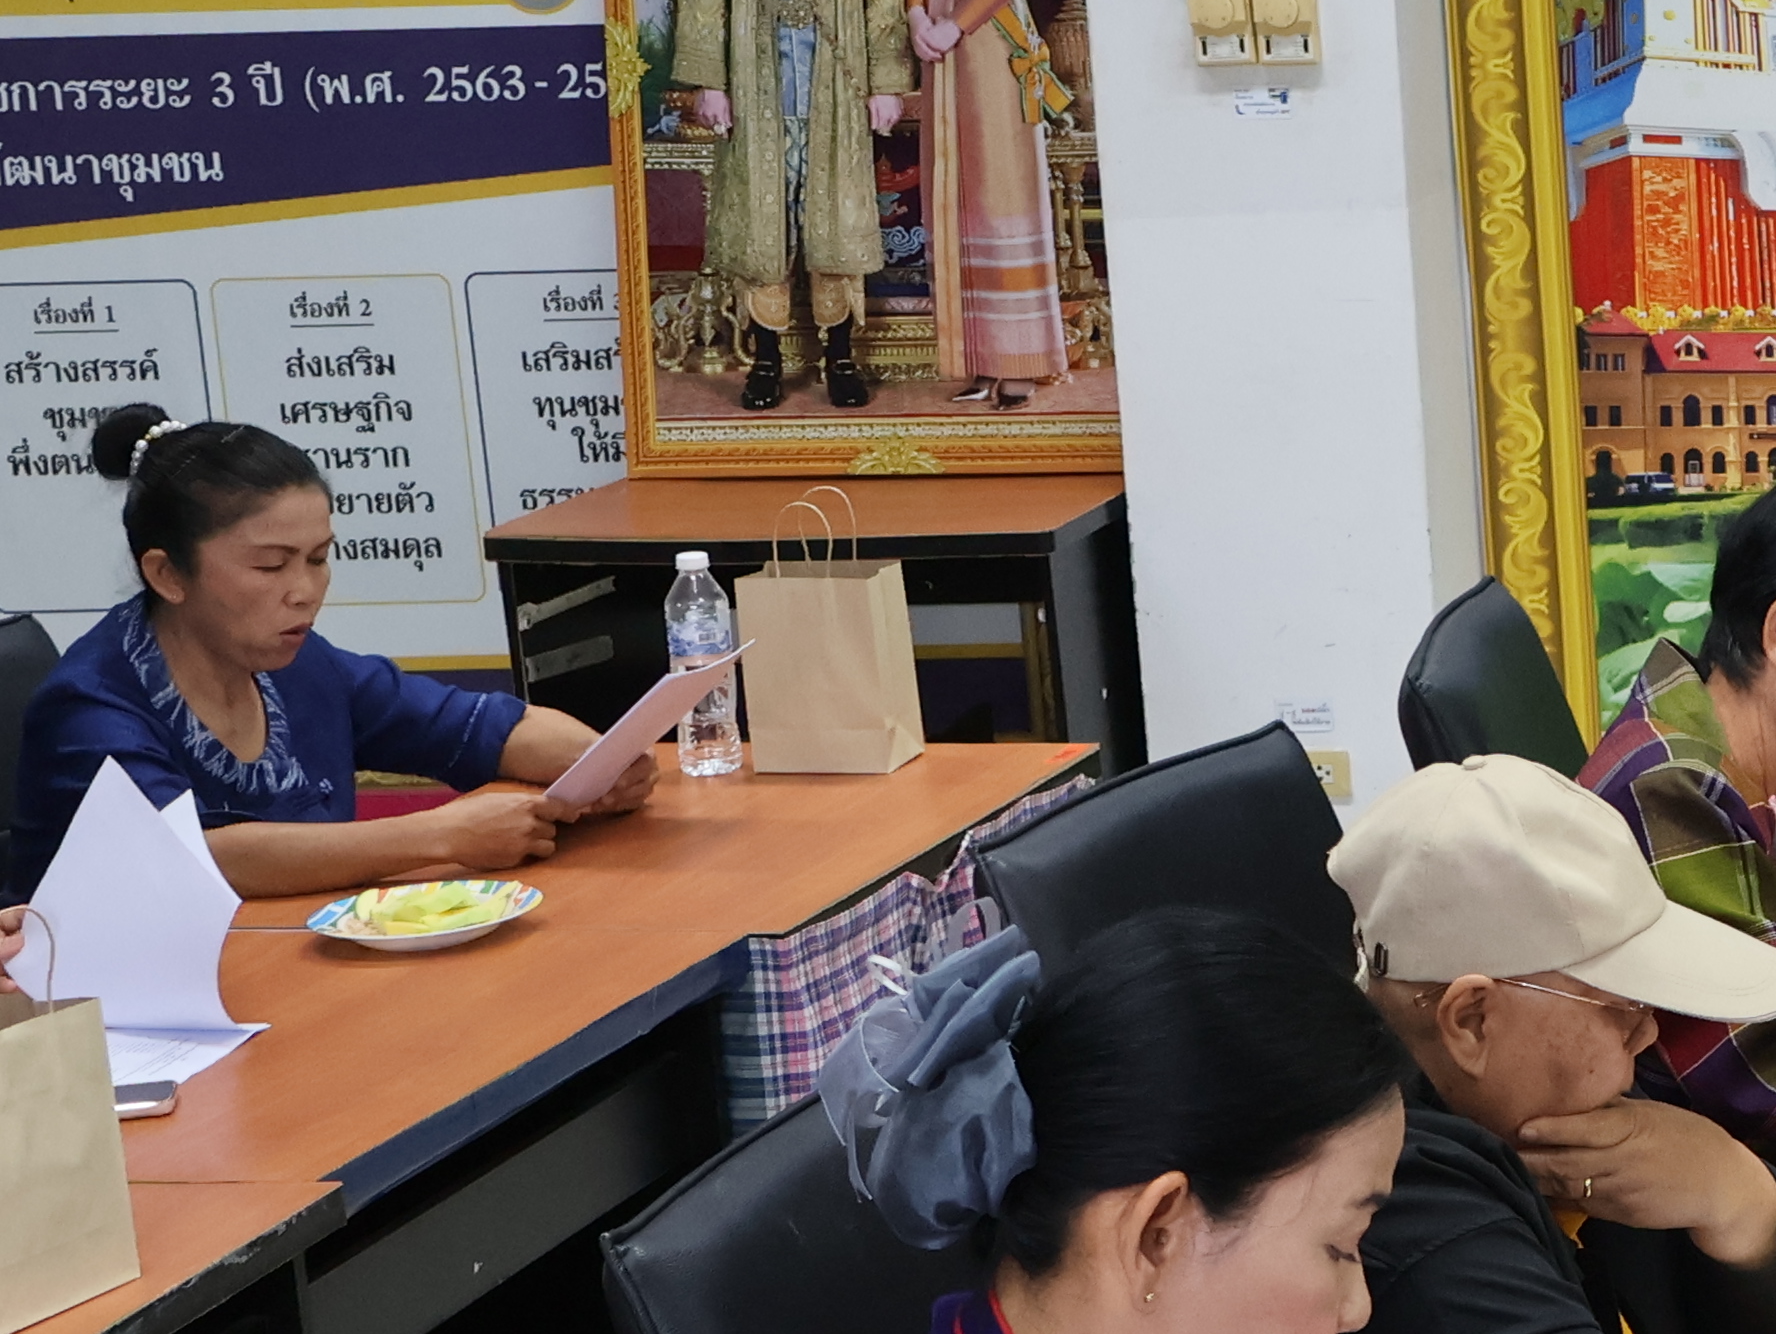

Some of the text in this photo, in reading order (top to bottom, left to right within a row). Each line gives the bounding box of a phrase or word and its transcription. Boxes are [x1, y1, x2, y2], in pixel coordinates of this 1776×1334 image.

[210, 71, 236, 107] 3
[247, 60, 285, 107] ปี
[304, 69, 404, 114] (พ.ศ.
[423, 65, 527, 103] 2563
[0, 144, 224, 202] ัฒนาชุมชน
[33, 297, 116, 324] เรื่องที่ 1
[289, 291, 374, 319] เรื่องที่ 2
[542, 285, 604, 313] เรื่องที่
[4, 348, 161, 385] สร้างสรรค์
[285, 346, 396, 378] ส่งเสริม
[280, 391, 413, 433] เศรษฐกิจ
[532, 393, 625, 433] ทุนชุม
[7, 438, 95, 476] พึ่งตน
[301, 443, 411, 471] านราก
[326, 482, 435, 516] ยายตัว
[333, 534, 444, 573] างสมดุล
